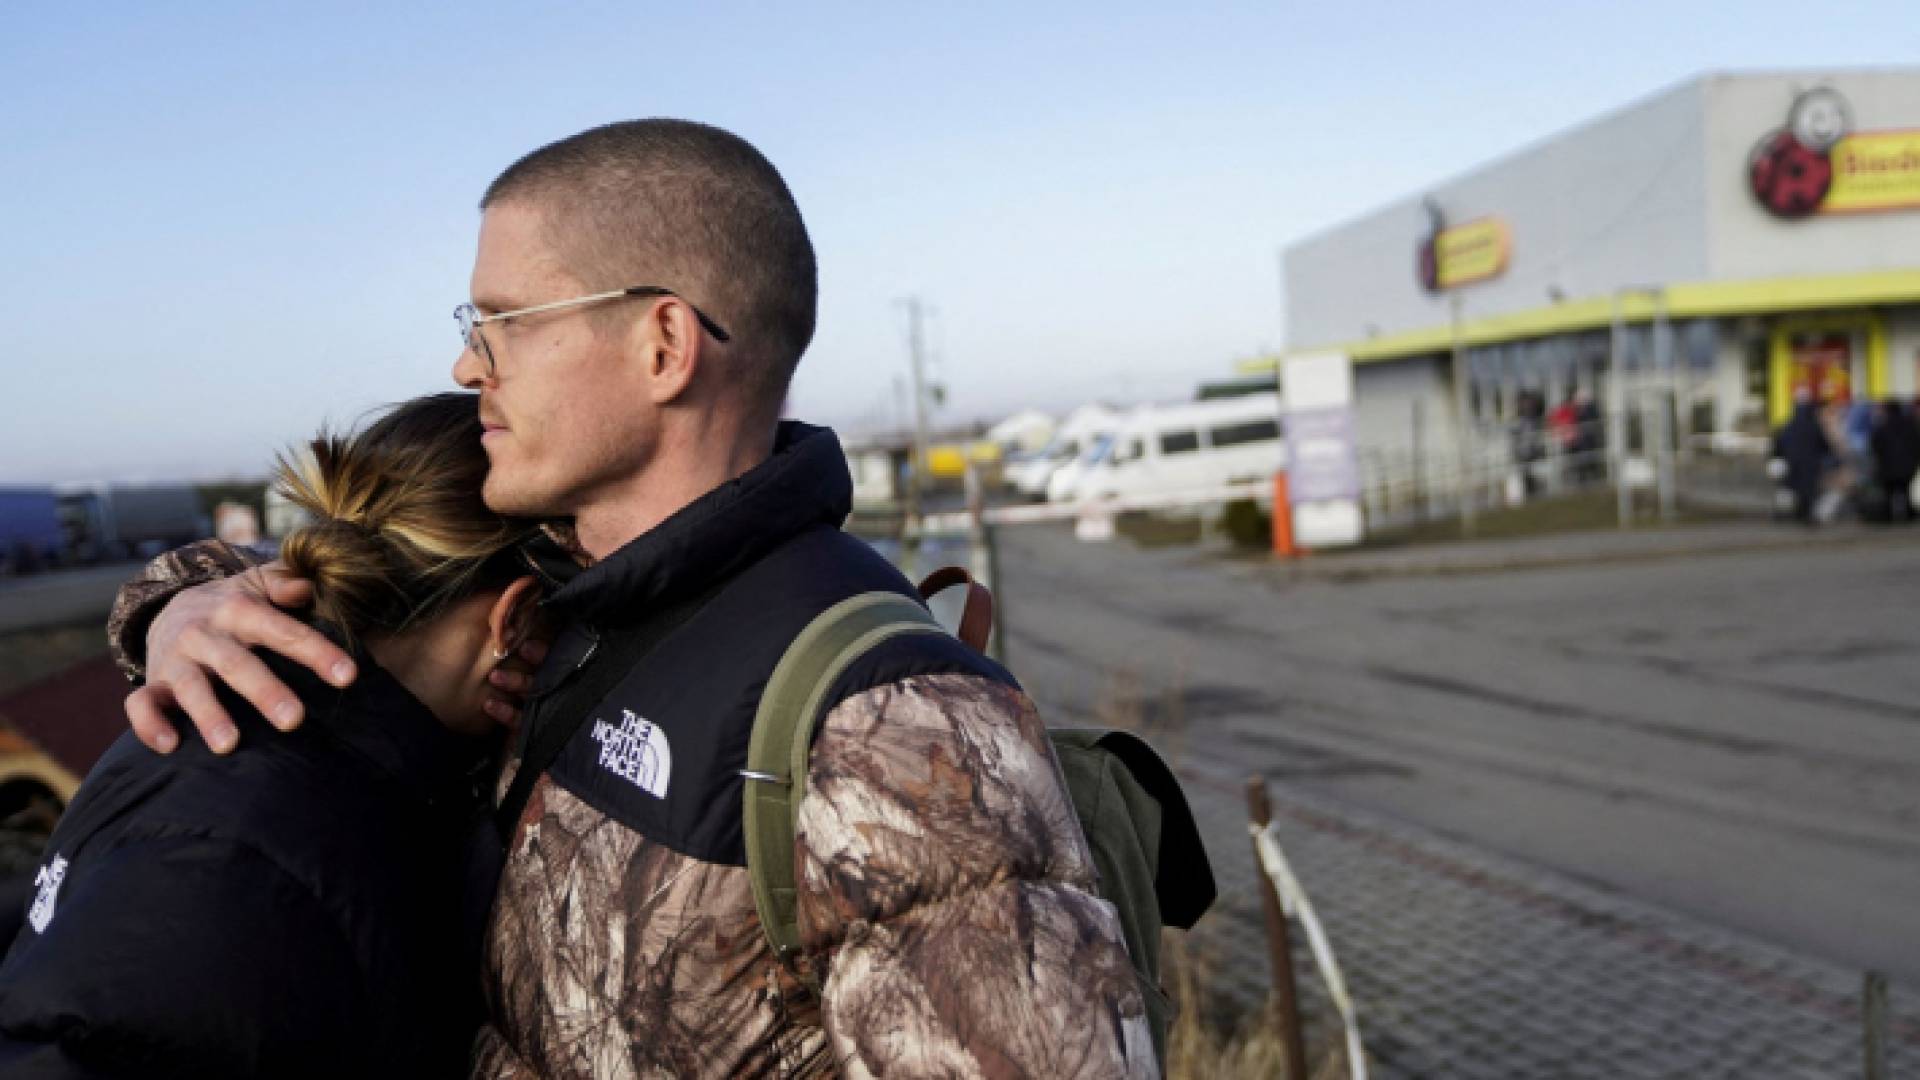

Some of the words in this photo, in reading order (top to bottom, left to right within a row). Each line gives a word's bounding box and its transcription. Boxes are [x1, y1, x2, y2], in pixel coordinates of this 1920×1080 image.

[591, 718, 641, 763] NORTH
[621, 709, 651, 740] THE
[599, 745, 638, 782] FACE
